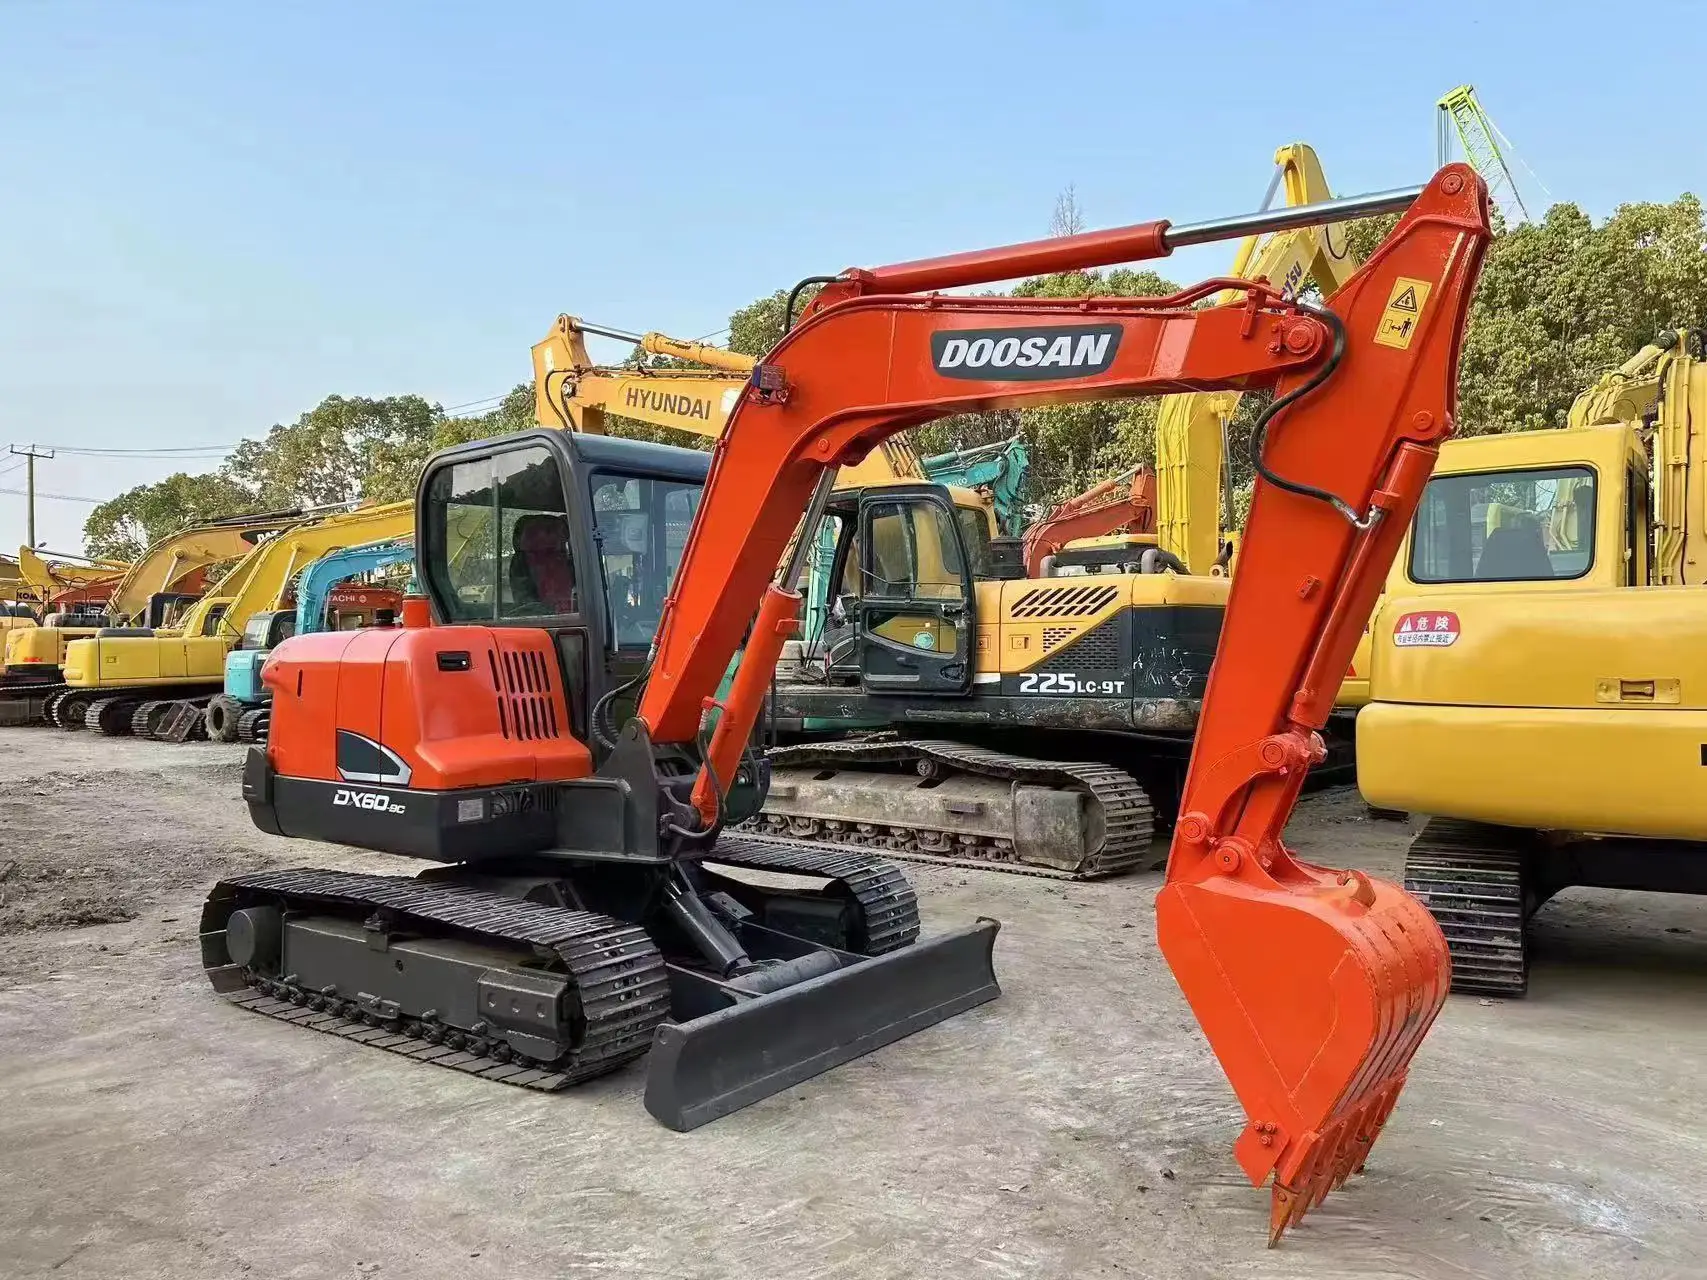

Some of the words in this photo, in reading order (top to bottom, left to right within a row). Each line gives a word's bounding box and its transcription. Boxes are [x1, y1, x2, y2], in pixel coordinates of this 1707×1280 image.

[939, 333, 1112, 368] DOOSAN
[626, 387, 712, 420] HYUNDAI
[18, 592, 39, 600] KOM
[333, 789, 406, 814] DX60-9C
